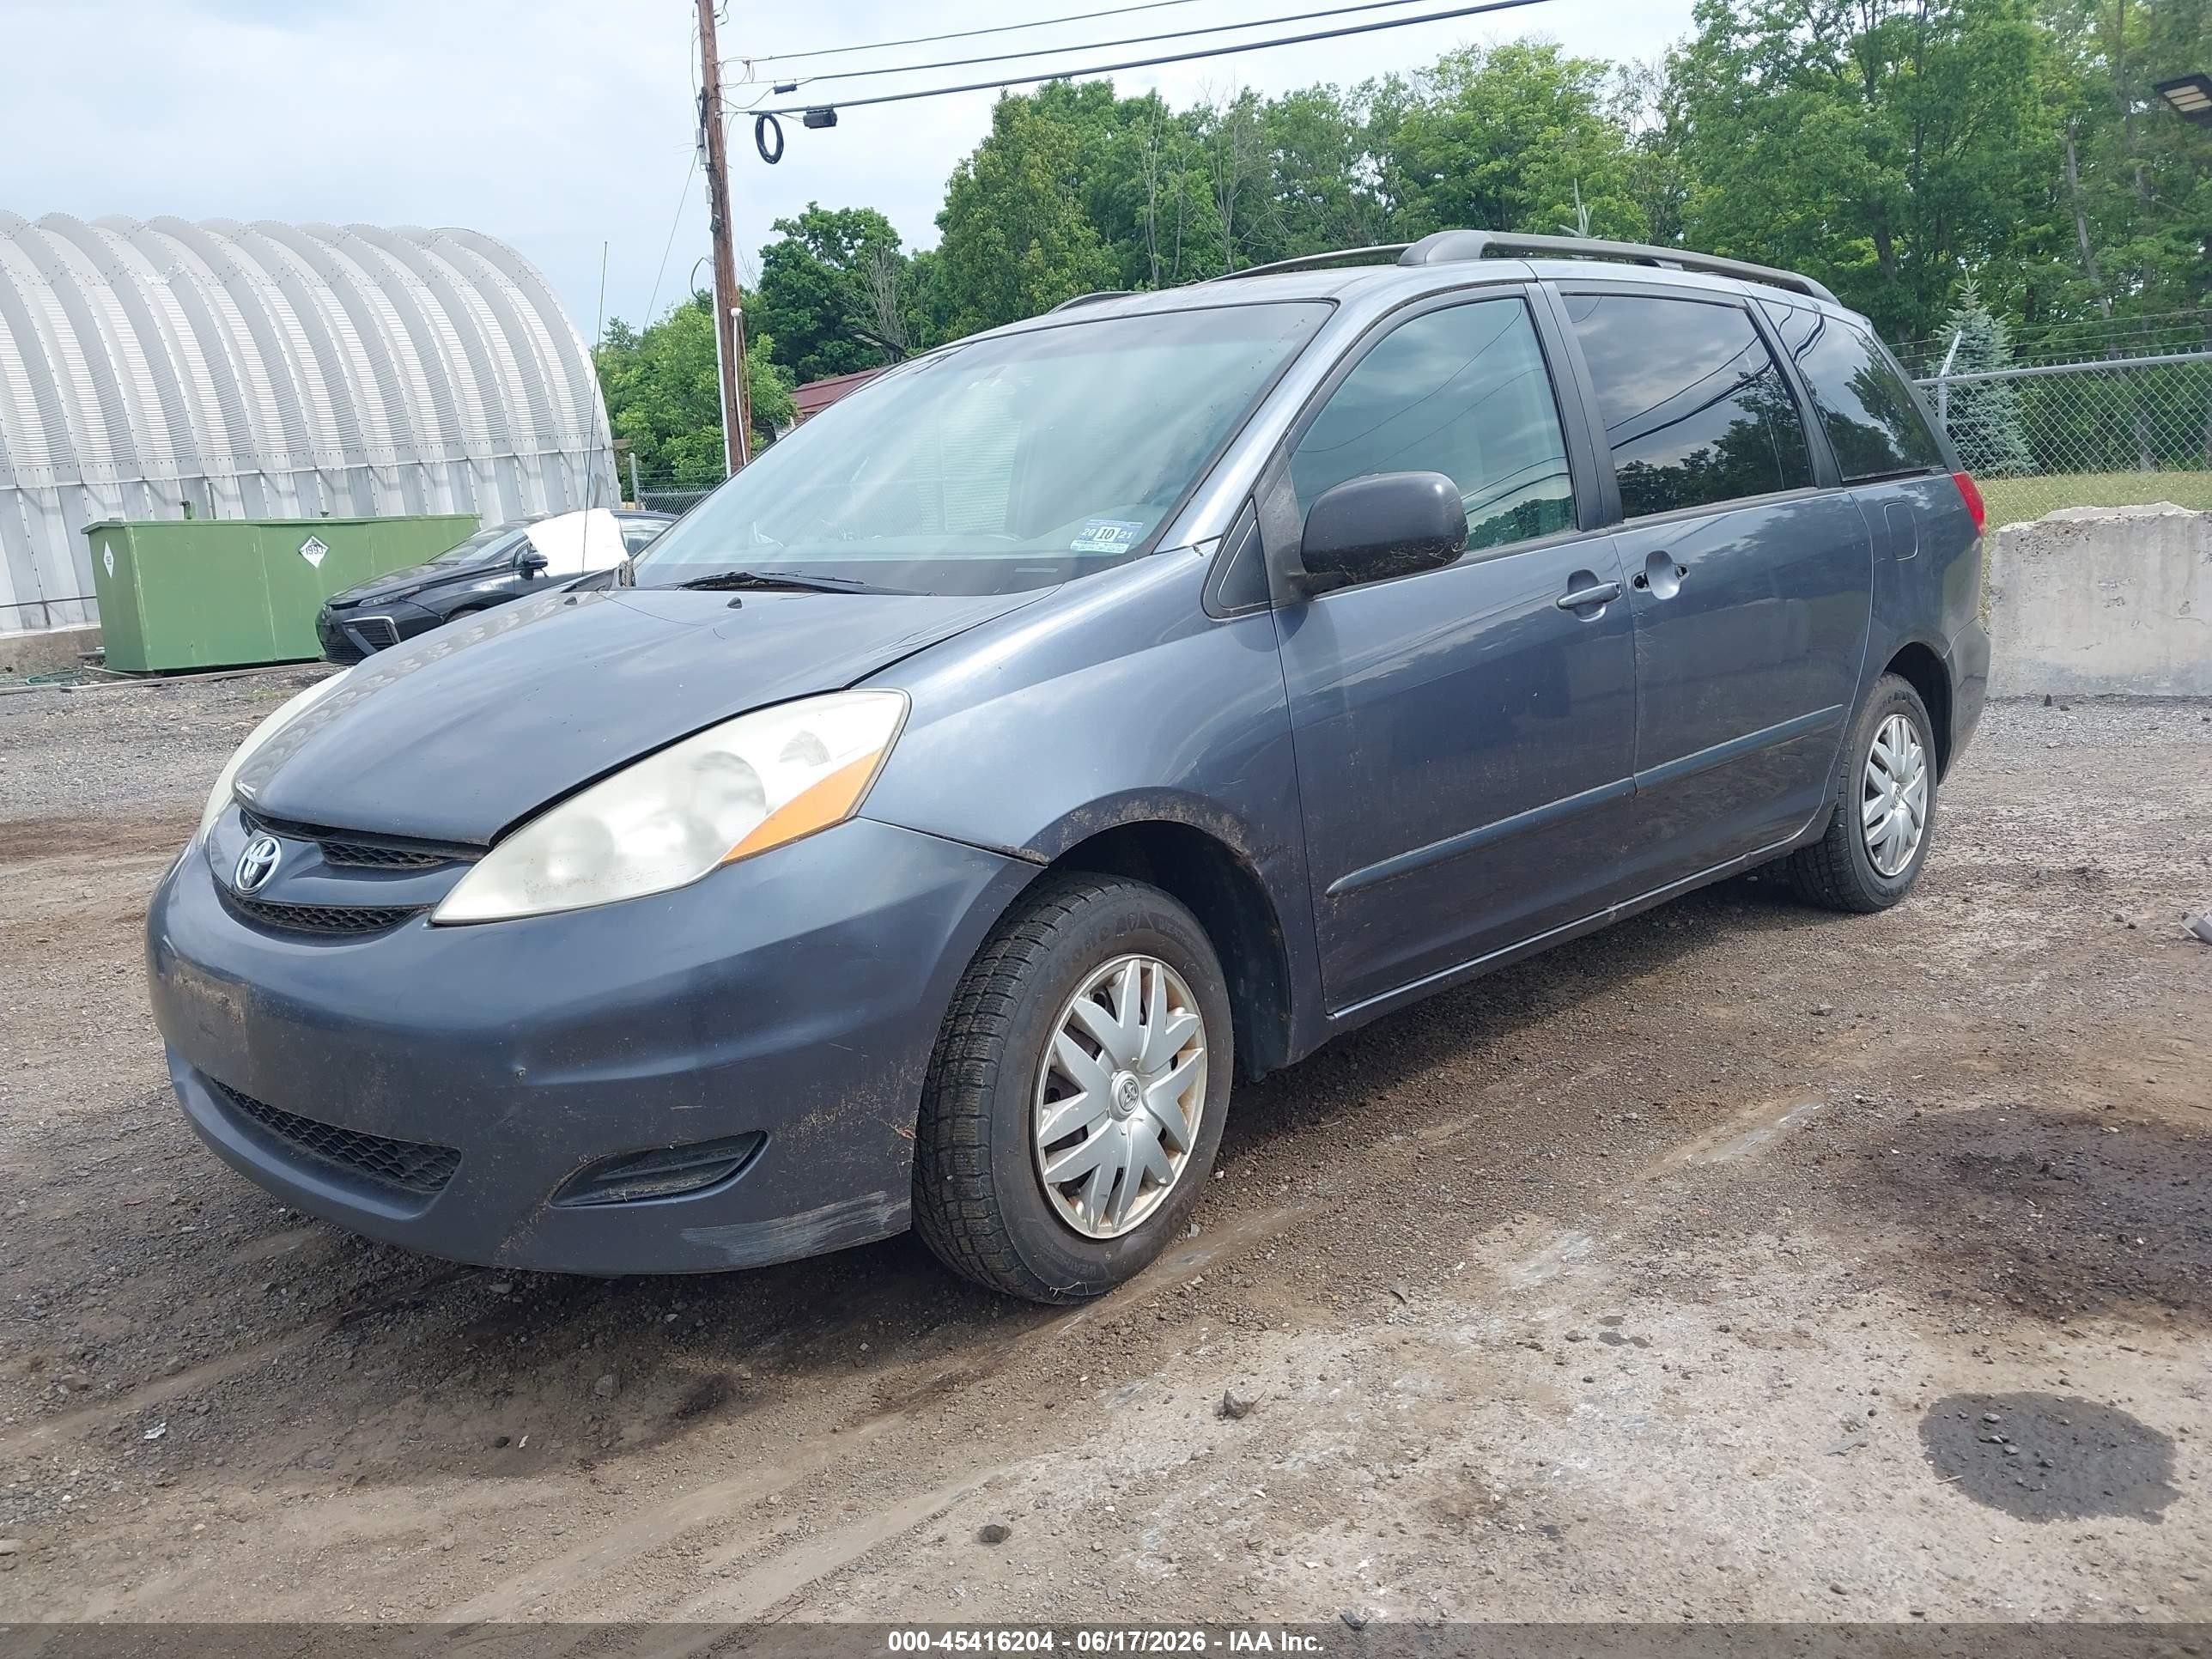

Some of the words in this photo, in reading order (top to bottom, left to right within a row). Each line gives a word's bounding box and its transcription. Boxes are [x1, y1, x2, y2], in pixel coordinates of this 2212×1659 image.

[1081, 528, 1097, 537] 20
[1097, 527, 1115, 540] 10
[1117, 531, 1133, 539] 21
[305, 544, 324, 555] 1993
